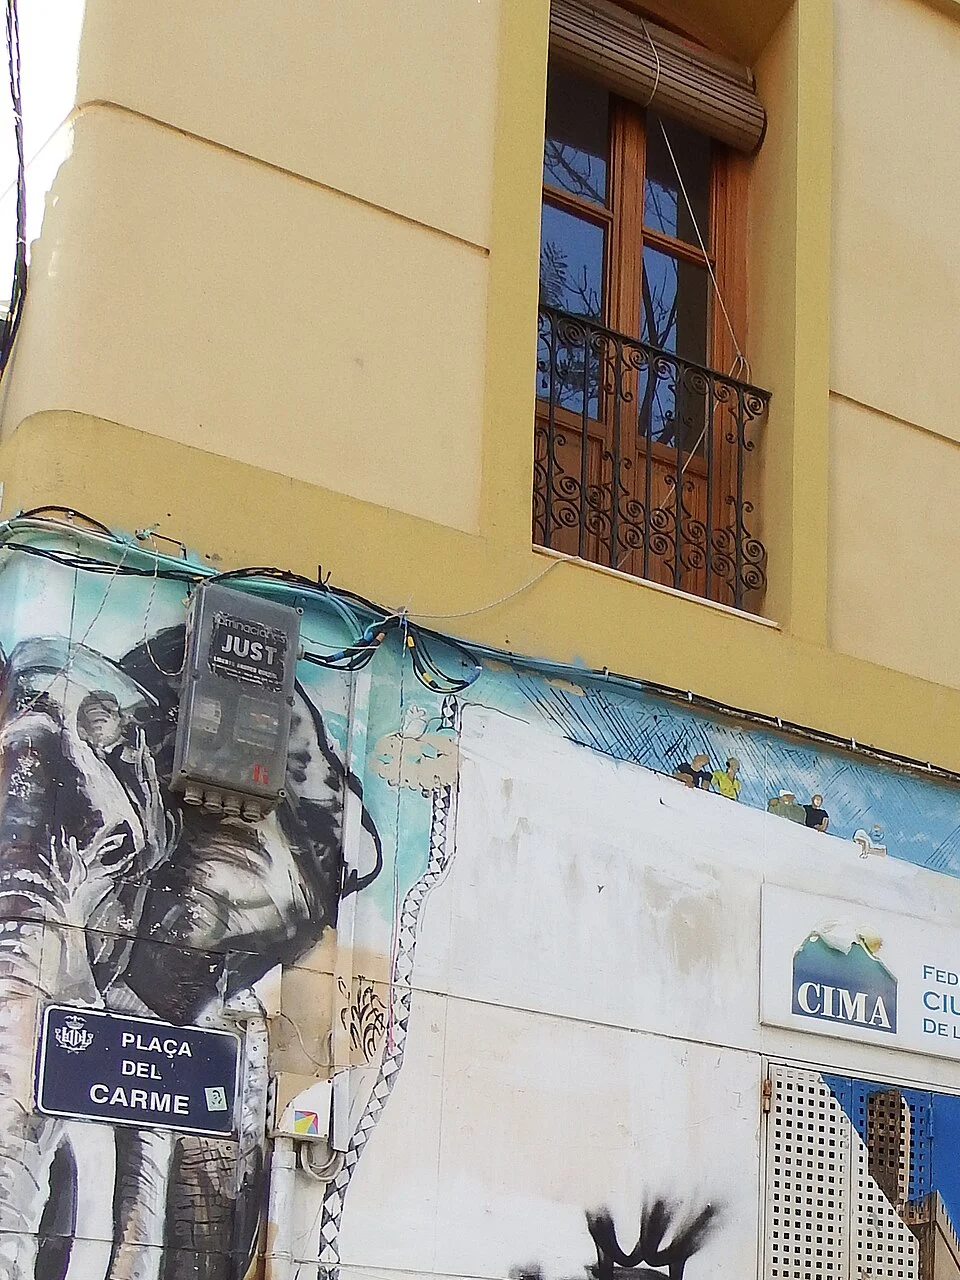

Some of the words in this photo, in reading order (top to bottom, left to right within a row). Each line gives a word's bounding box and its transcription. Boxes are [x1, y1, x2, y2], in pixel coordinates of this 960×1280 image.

[221, 634, 277, 665] JUST
[797, 981, 892, 1029] CIMA
[922, 1017, 949, 1037] DE
[121, 1032, 193, 1059] PLAÇA
[121, 1059, 163, 1080] DEL
[89, 1083, 191, 1115] CARME
